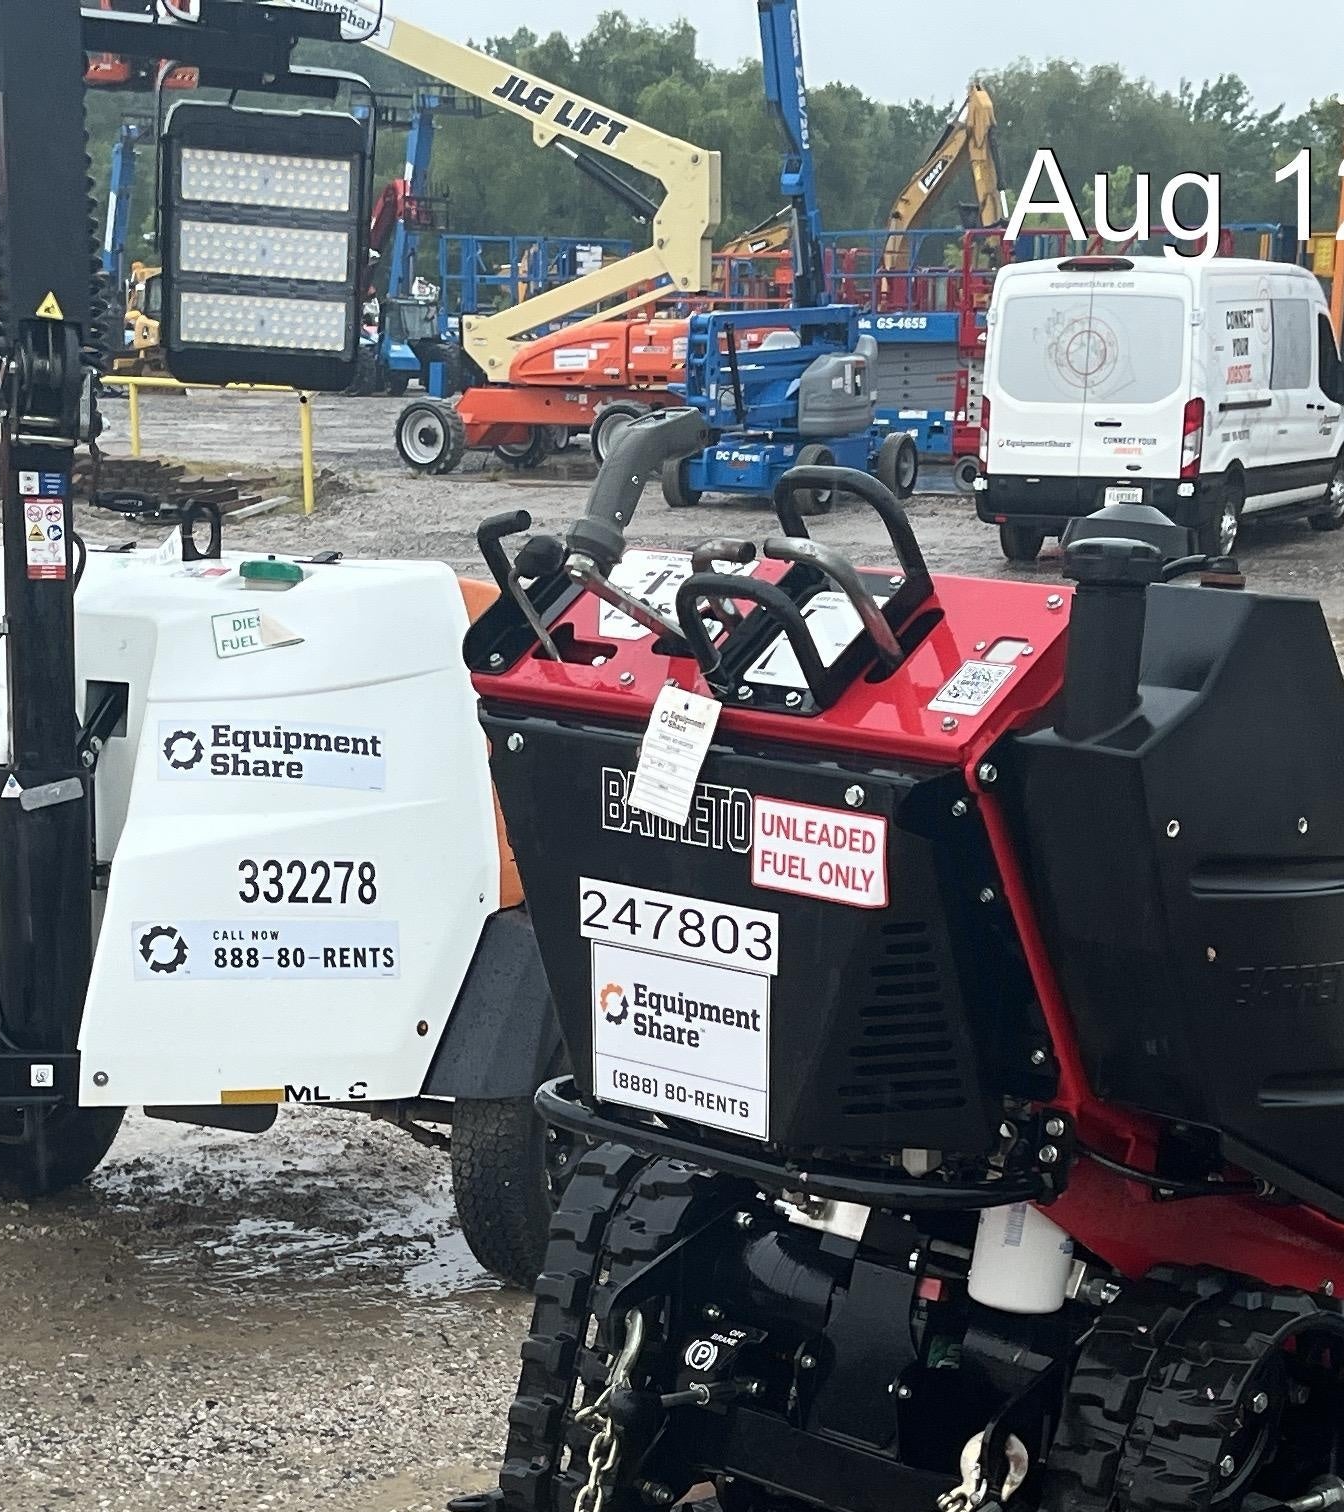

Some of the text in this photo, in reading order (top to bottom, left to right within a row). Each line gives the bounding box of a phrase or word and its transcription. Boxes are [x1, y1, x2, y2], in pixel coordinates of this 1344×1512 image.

[492, 75, 629, 146] JLG LIFT
[1049, 281, 1135, 290] equipmentshare.com
[876, 317, 927, 330] GS-4655
[1226, 309, 1255, 331] CONNECT
[716, 450, 730, 461] DC
[1006, 439, 1072, 449] EquipmentShare
[221, 635, 258, 652] FUEL
[210, 724, 382, 757] Equipment
[210, 753, 304, 779] Share
[761, 812, 876, 855] UNLEADED
[238, 859, 378, 905] 332278
[760, 850, 875, 893] FUEL ONLY
[212, 930, 280, 941] CALL NOW
[582, 889, 773, 961] 247803
[214, 947, 395, 969] 888-80-RENTS
[632, 983, 761, 1033] Equipment
[632, 1013, 700, 1048] Share
[612, 1069, 750, 1119] (888) 80-RENTS
[710, 1333, 738, 1346] BRAKE
[729, 1329, 747, 1339] OFF
